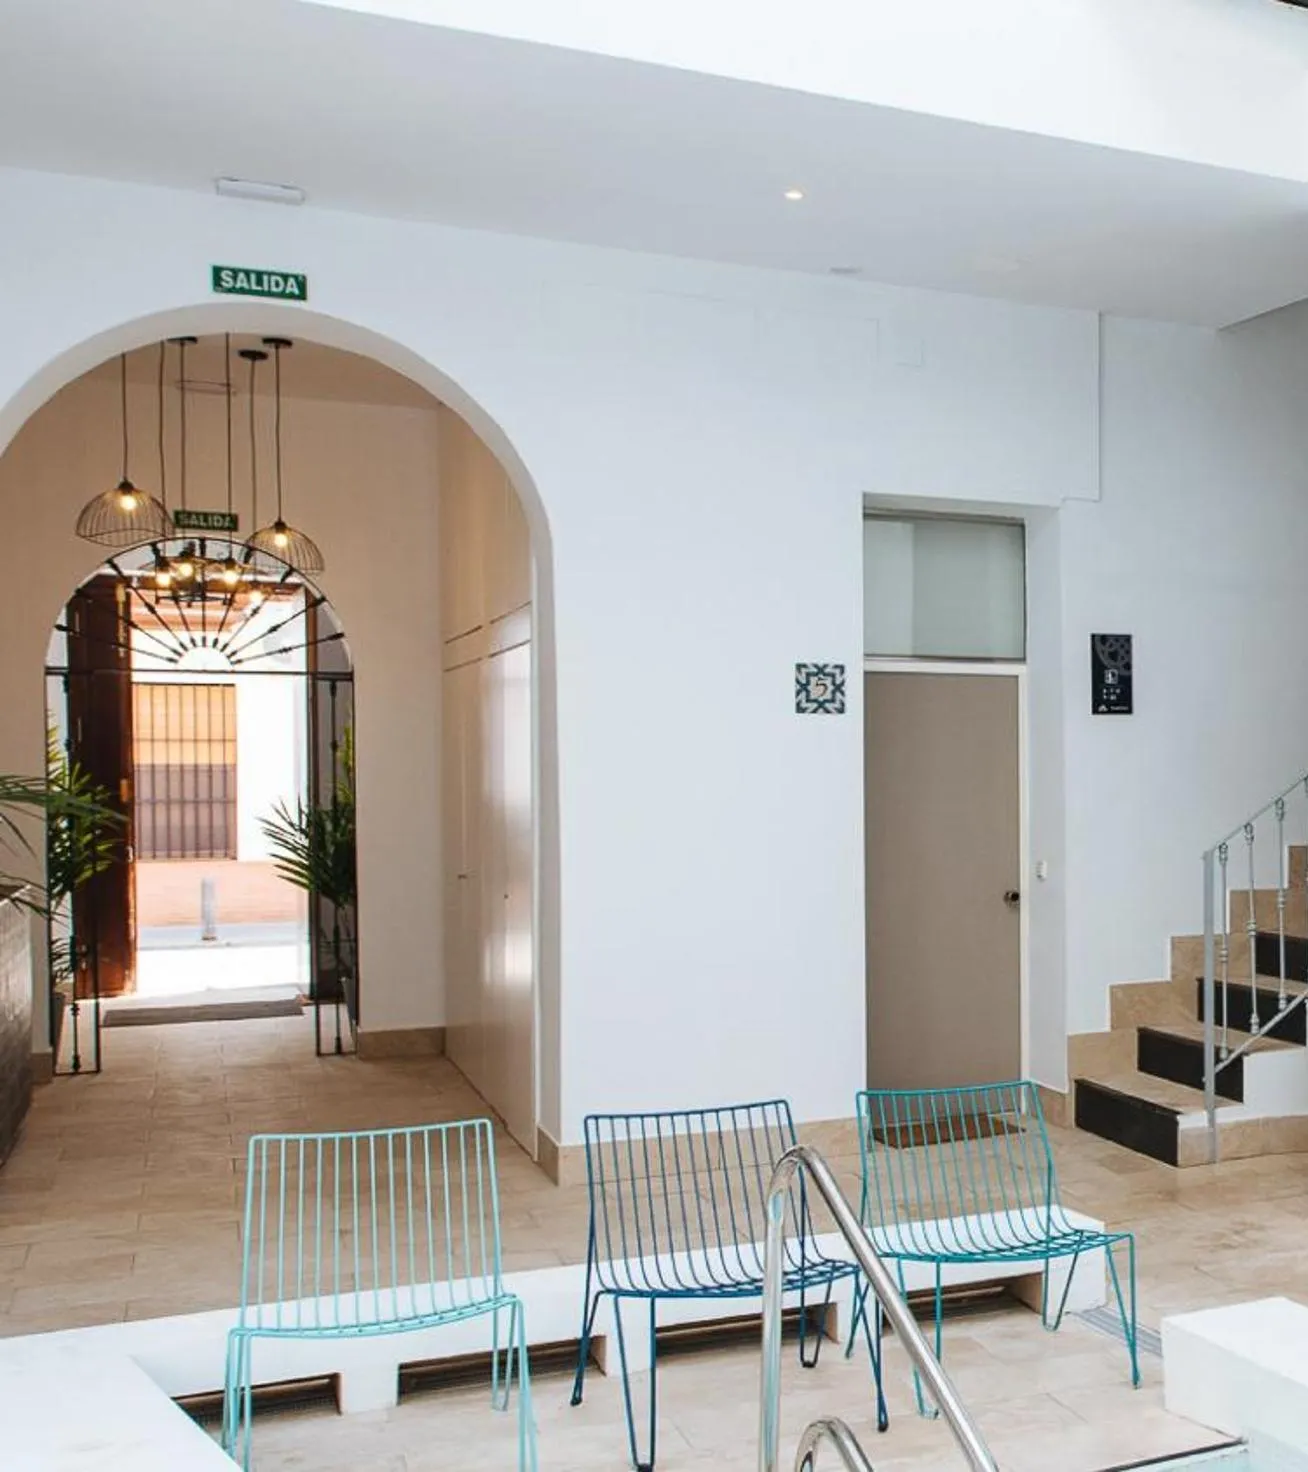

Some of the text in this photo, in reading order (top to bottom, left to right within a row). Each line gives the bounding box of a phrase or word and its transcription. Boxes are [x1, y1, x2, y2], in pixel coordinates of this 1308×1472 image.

[220, 270, 300, 295] SALIDA
[178, 513, 235, 528] SALIDA
[815, 676, 829, 697] 5
